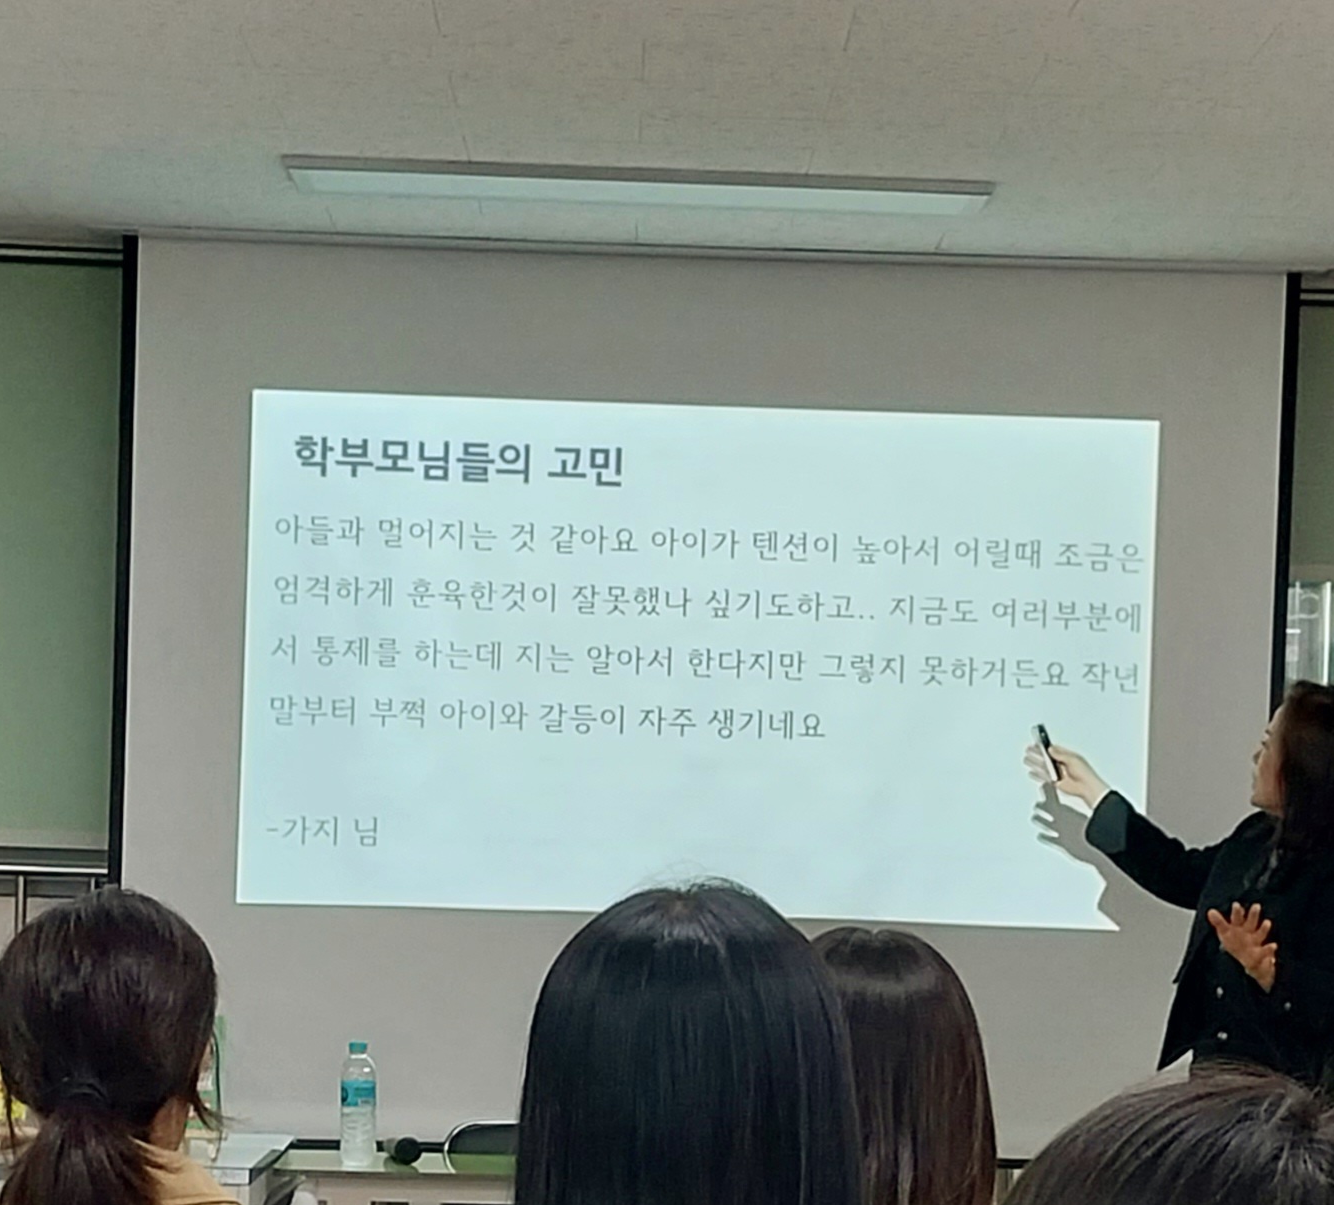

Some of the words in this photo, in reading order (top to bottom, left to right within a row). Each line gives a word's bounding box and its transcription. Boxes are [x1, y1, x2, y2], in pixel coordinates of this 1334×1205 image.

[294, 435, 531, 483] 학부모님들의
[547, 445, 624, 487] 고민
[274, 513, 365, 548] 아들과
[378, 517, 498, 553] 멀어지는
[509, 521, 537, 554] 것
[549, 523, 639, 556] 같아요
[651, 526, 740, 560] 아이가
[752, 529, 839, 564] 텐션이
[852, 533, 940, 567] 높아서
[954, 536, 1042, 570] 어릴때
[1054, 540, 1145, 575] 조금은
[274, 574, 394, 608] 엄격하게
[406, 578, 557, 613] 훈육한것이
[571, 583, 693, 618] 잘못했나
[703, 588, 876, 622] 싶기도하고..
[889, 594, 979, 627] 지금도
[991, 598, 1142, 634] 여러부분에
[270, 634, 298, 666] 서
[311, 635, 402, 668] 통제를
[414, 638, 503, 672] 하는데
[516, 641, 575, 674] 지는
[586, 643, 675, 677] 알아서
[688, 646, 806, 682] 한다지만
[818, 652, 905, 686] 그렇지
[918, 655, 1070, 690] 못하거든요
[1081, 659, 1140, 695] 작년
[269, 694, 357, 728] 말부터
[369, 697, 427, 730] 부쩍
[439, 698, 529, 733] 아이와
[538, 701, 626, 736] 갈등이
[637, 705, 698, 738] 자주
[706, 707, 826, 741] 생기네요
[265, 815, 340, 847] -가지
[354, 815, 380, 848] 님
